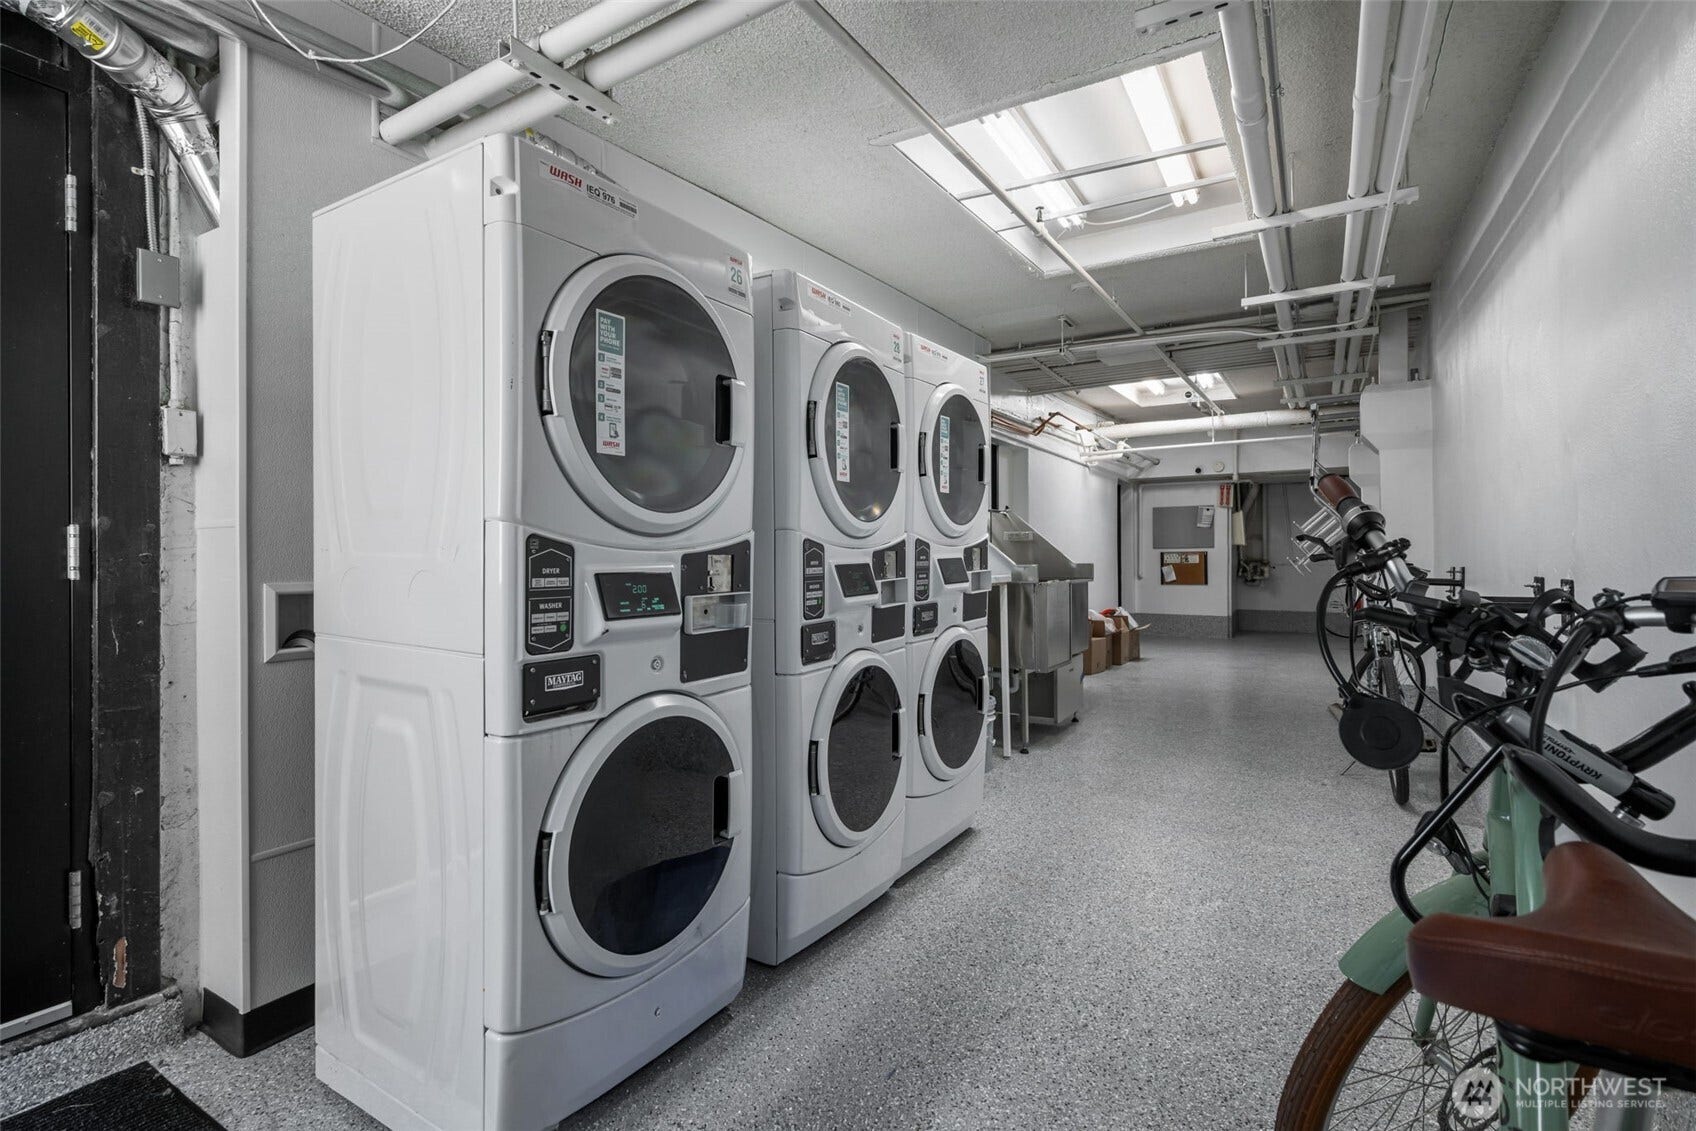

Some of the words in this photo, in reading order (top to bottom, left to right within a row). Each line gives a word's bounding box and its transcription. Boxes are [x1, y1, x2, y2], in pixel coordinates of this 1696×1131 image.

[549, 165, 583, 188] WASH
[730, 266, 743, 285] 26
[541, 567, 560, 575] DRYER
[538, 602, 563, 610] WASHER
[547, 672, 582, 686] MAYTAG
[1543, 741, 1603, 781] KRYPTONI
